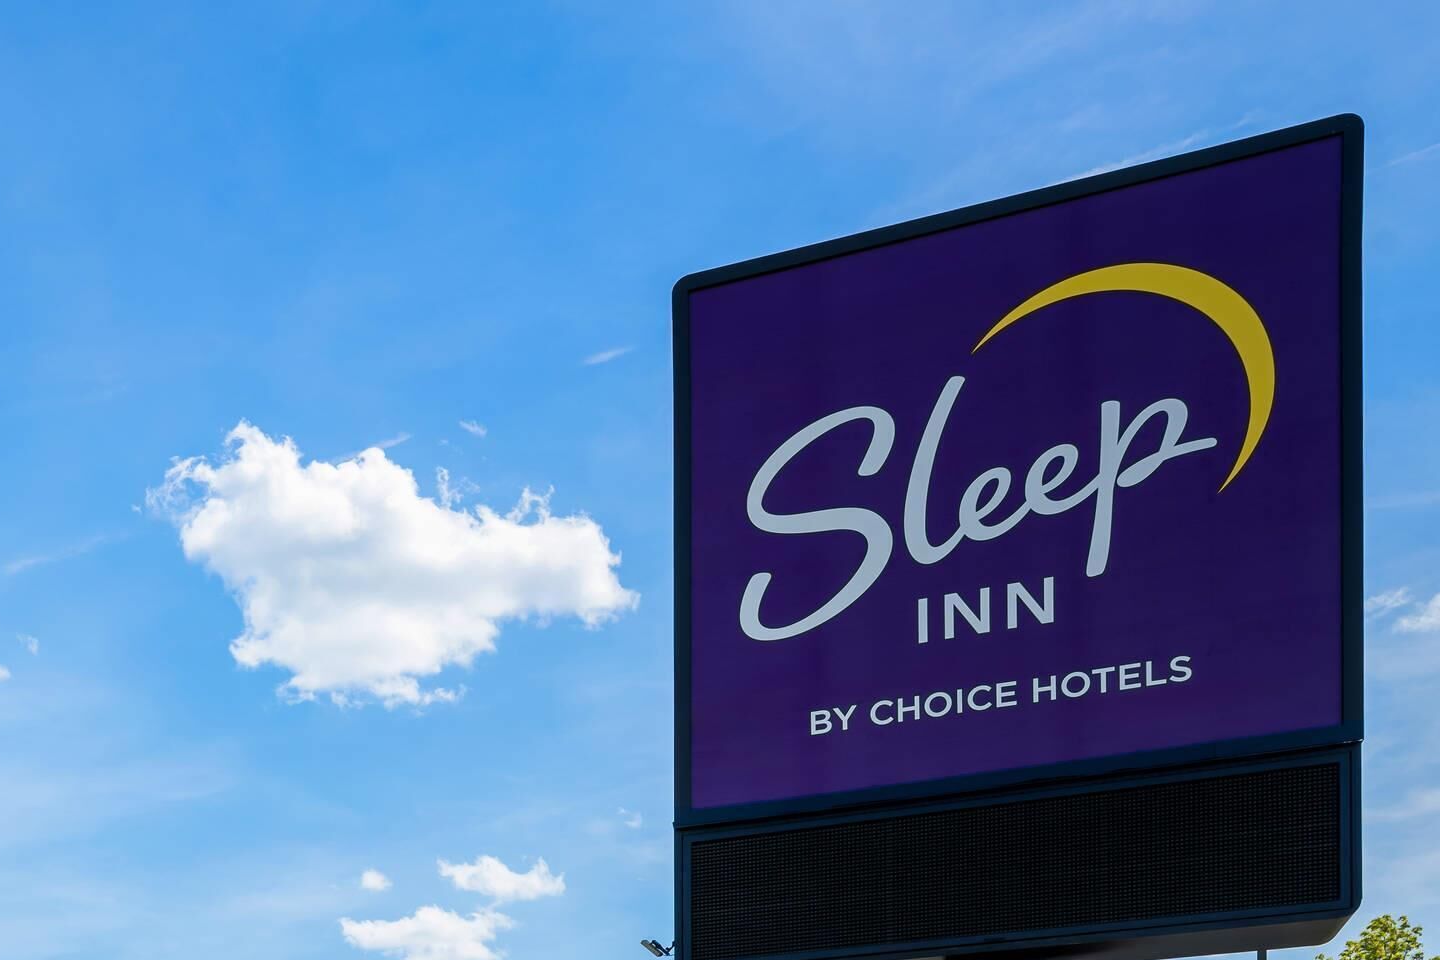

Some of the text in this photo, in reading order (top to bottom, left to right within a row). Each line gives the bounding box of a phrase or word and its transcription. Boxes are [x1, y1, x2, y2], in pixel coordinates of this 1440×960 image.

[739, 375, 1218, 642] Sleep
[917, 576, 1058, 645] INN
[809, 655, 1194, 737] BY CHOICE HOTELS
